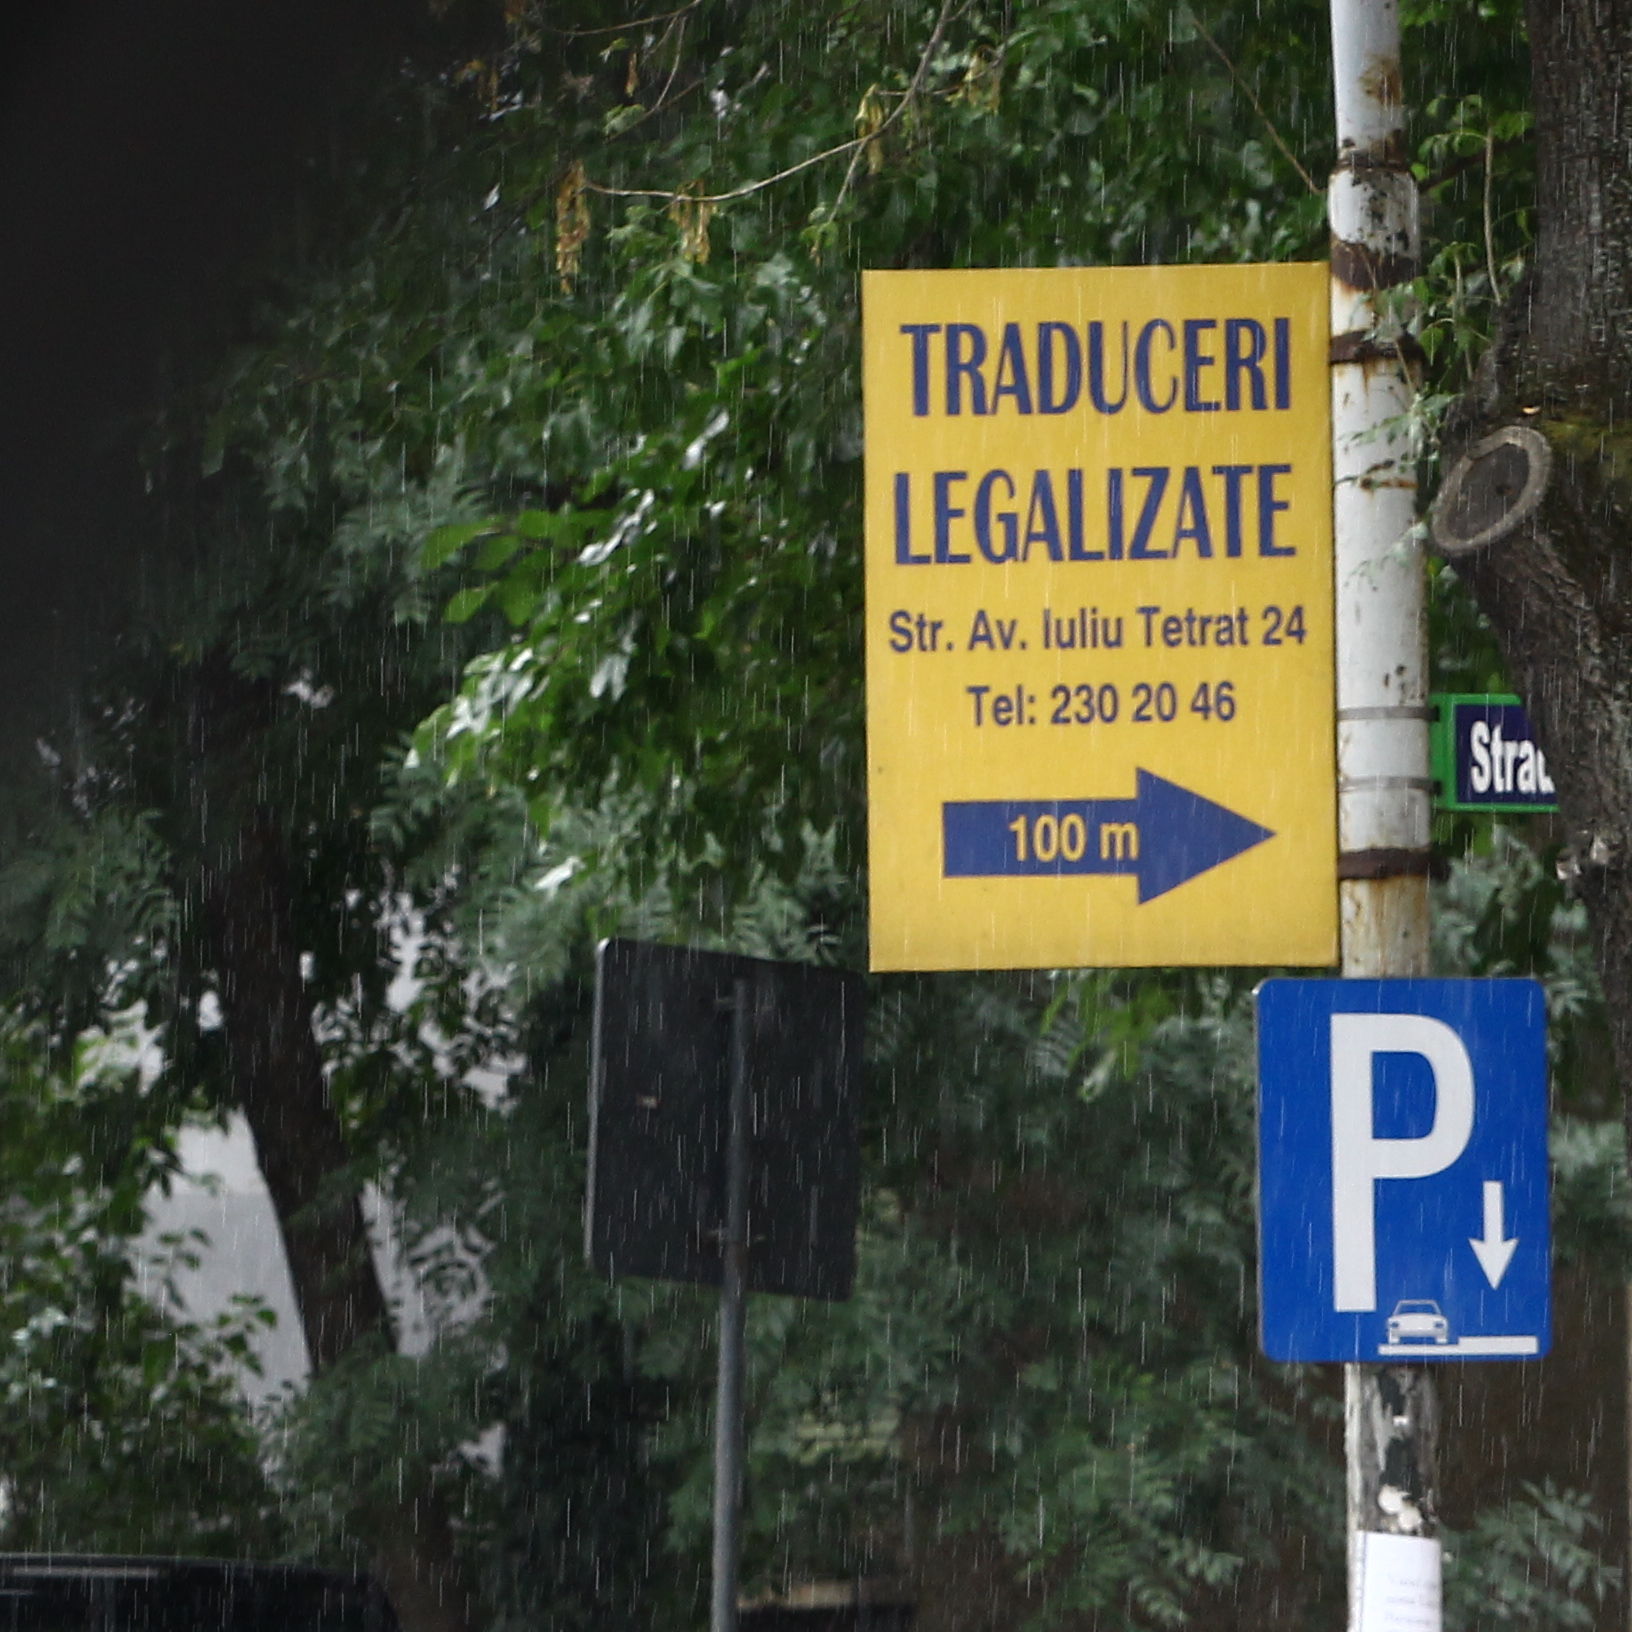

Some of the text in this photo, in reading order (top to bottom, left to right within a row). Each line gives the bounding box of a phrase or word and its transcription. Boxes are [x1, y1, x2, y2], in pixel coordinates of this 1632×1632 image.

[900, 317, 1292, 417] TRADUCERI
[894, 463, 1297, 565] LEGALIZATE
[889, 604, 1307, 653] Str. Av. Iuliu Tetrat 24
[966, 680, 1236, 727] Tel: 230 20 46
[1009, 813, 1138, 862] 100 m
[1331, 1013, 1476, 1313] P
